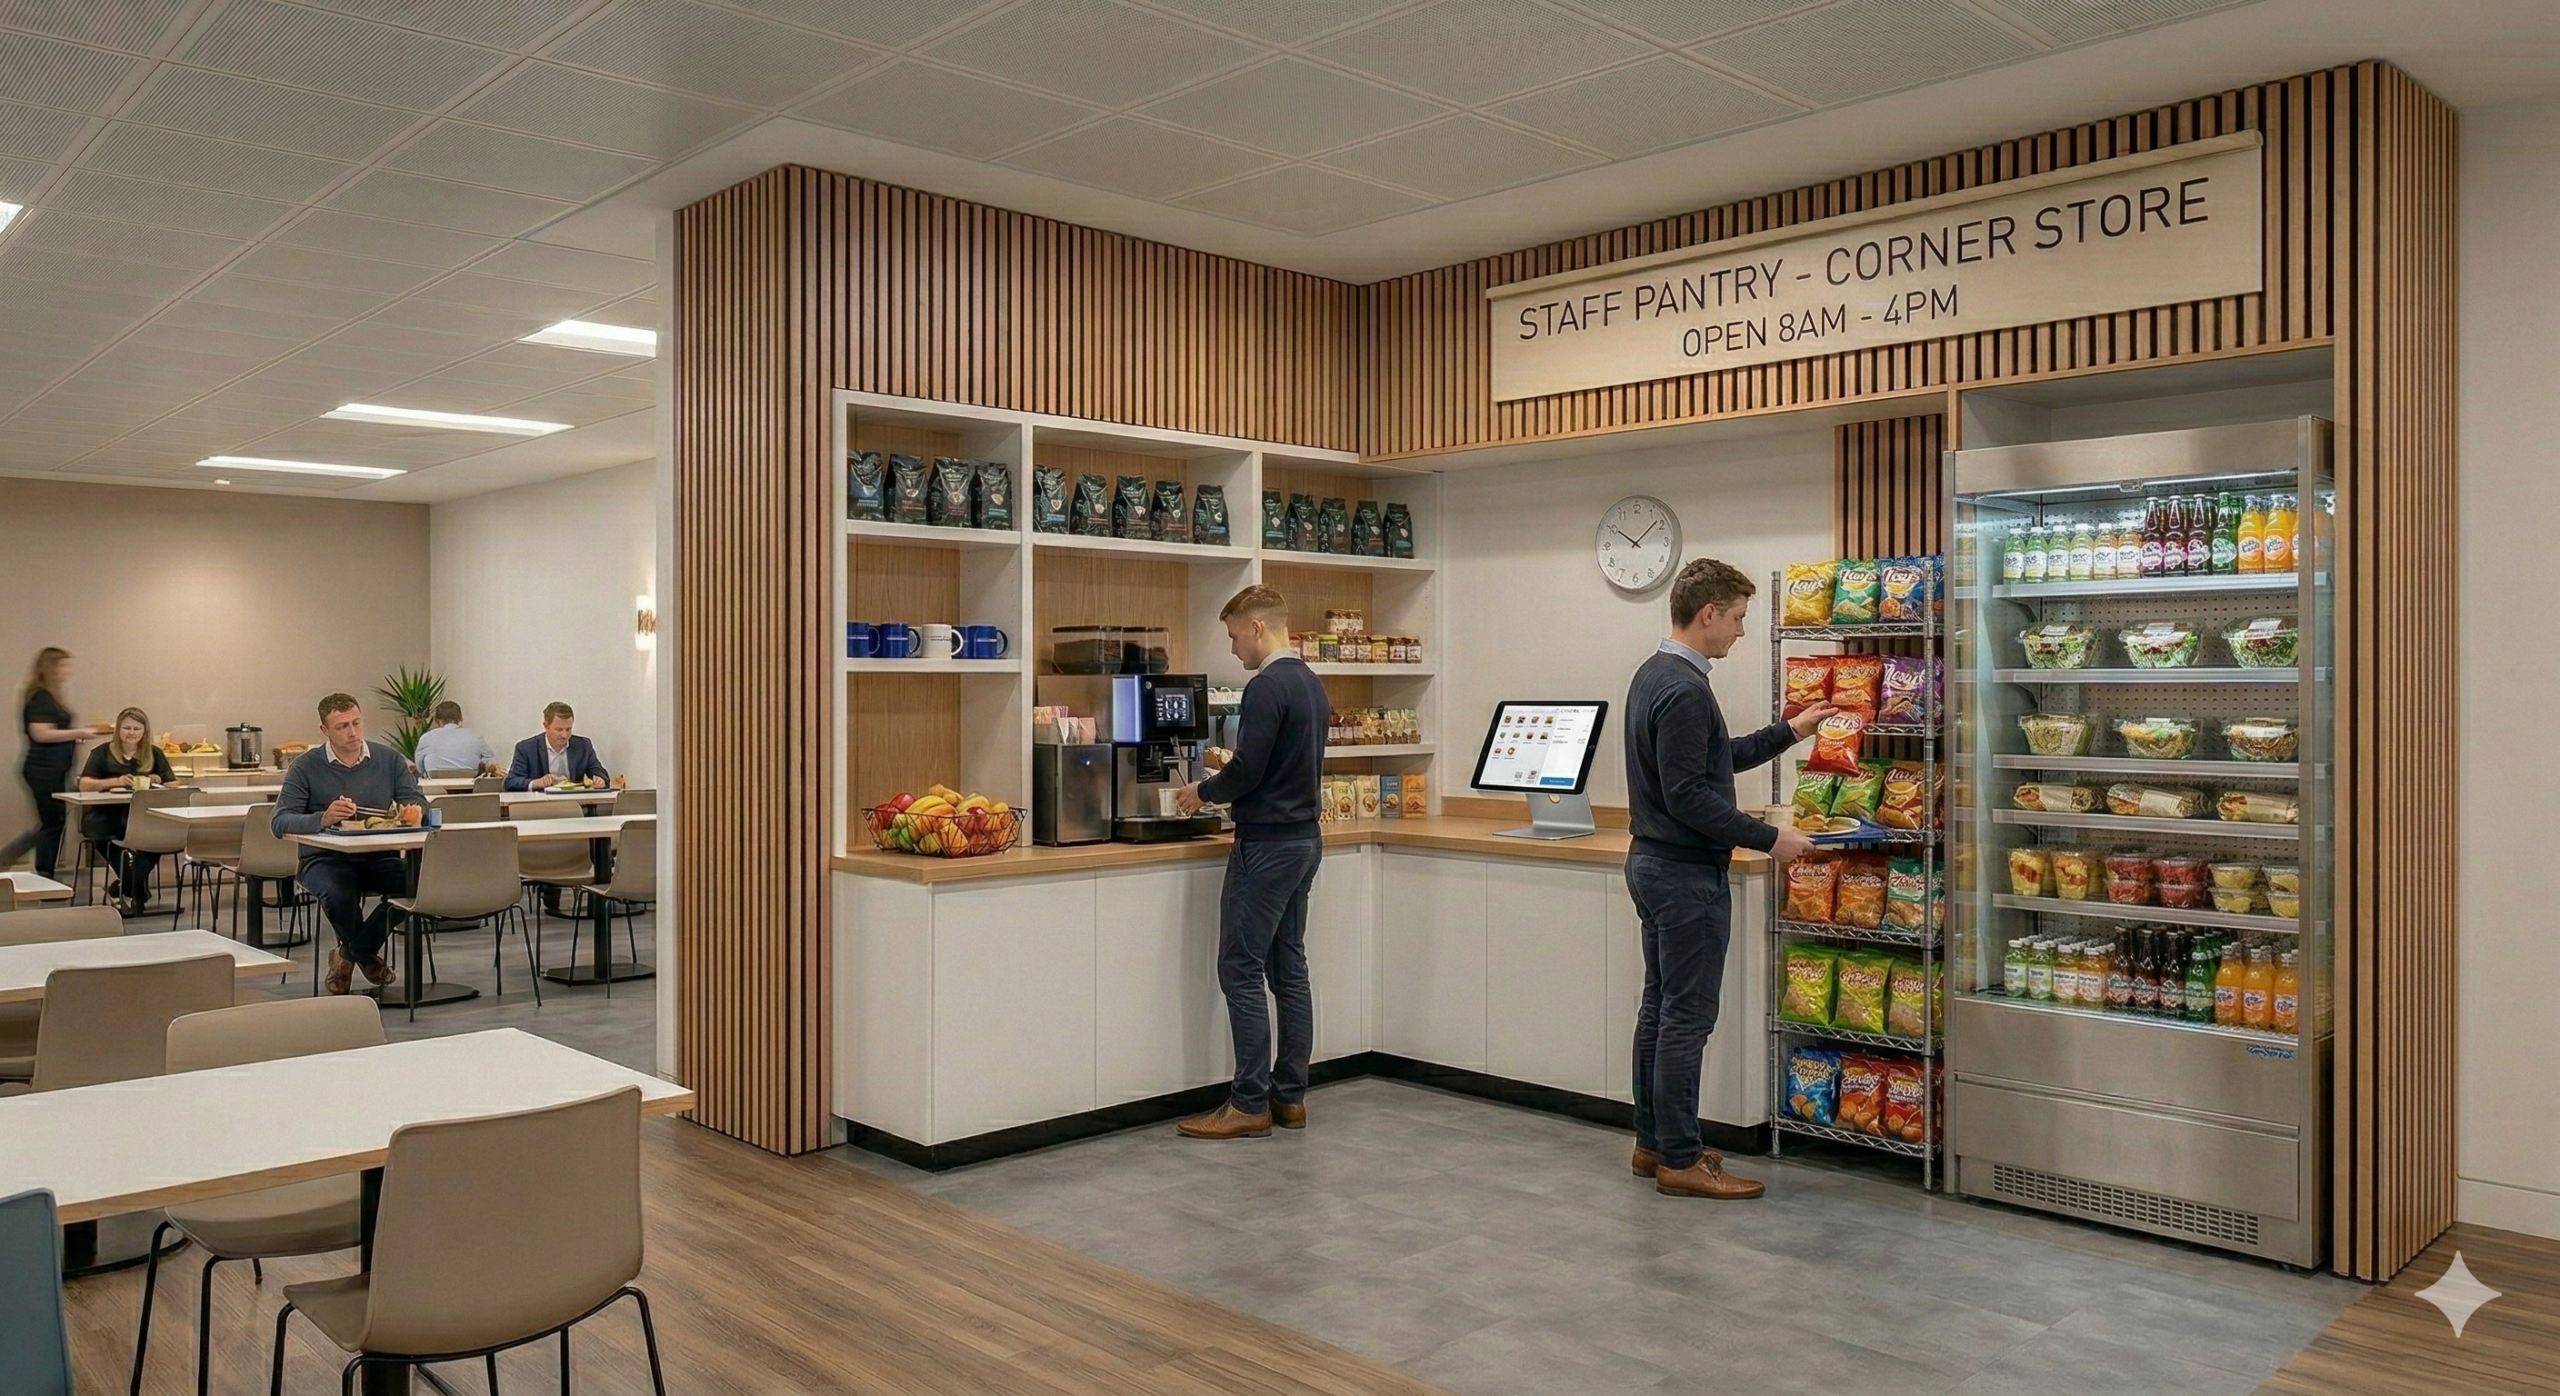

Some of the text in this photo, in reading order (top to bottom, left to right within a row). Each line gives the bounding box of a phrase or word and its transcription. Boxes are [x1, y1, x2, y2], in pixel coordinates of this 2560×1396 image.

[1519, 176, 2209, 341] STAFF PANTRY - CORNER STORE
[1682, 316, 1767, 358] OPEN
[1778, 303, 1846, 343] 8AM
[1883, 283, 1958, 326] 4PM
